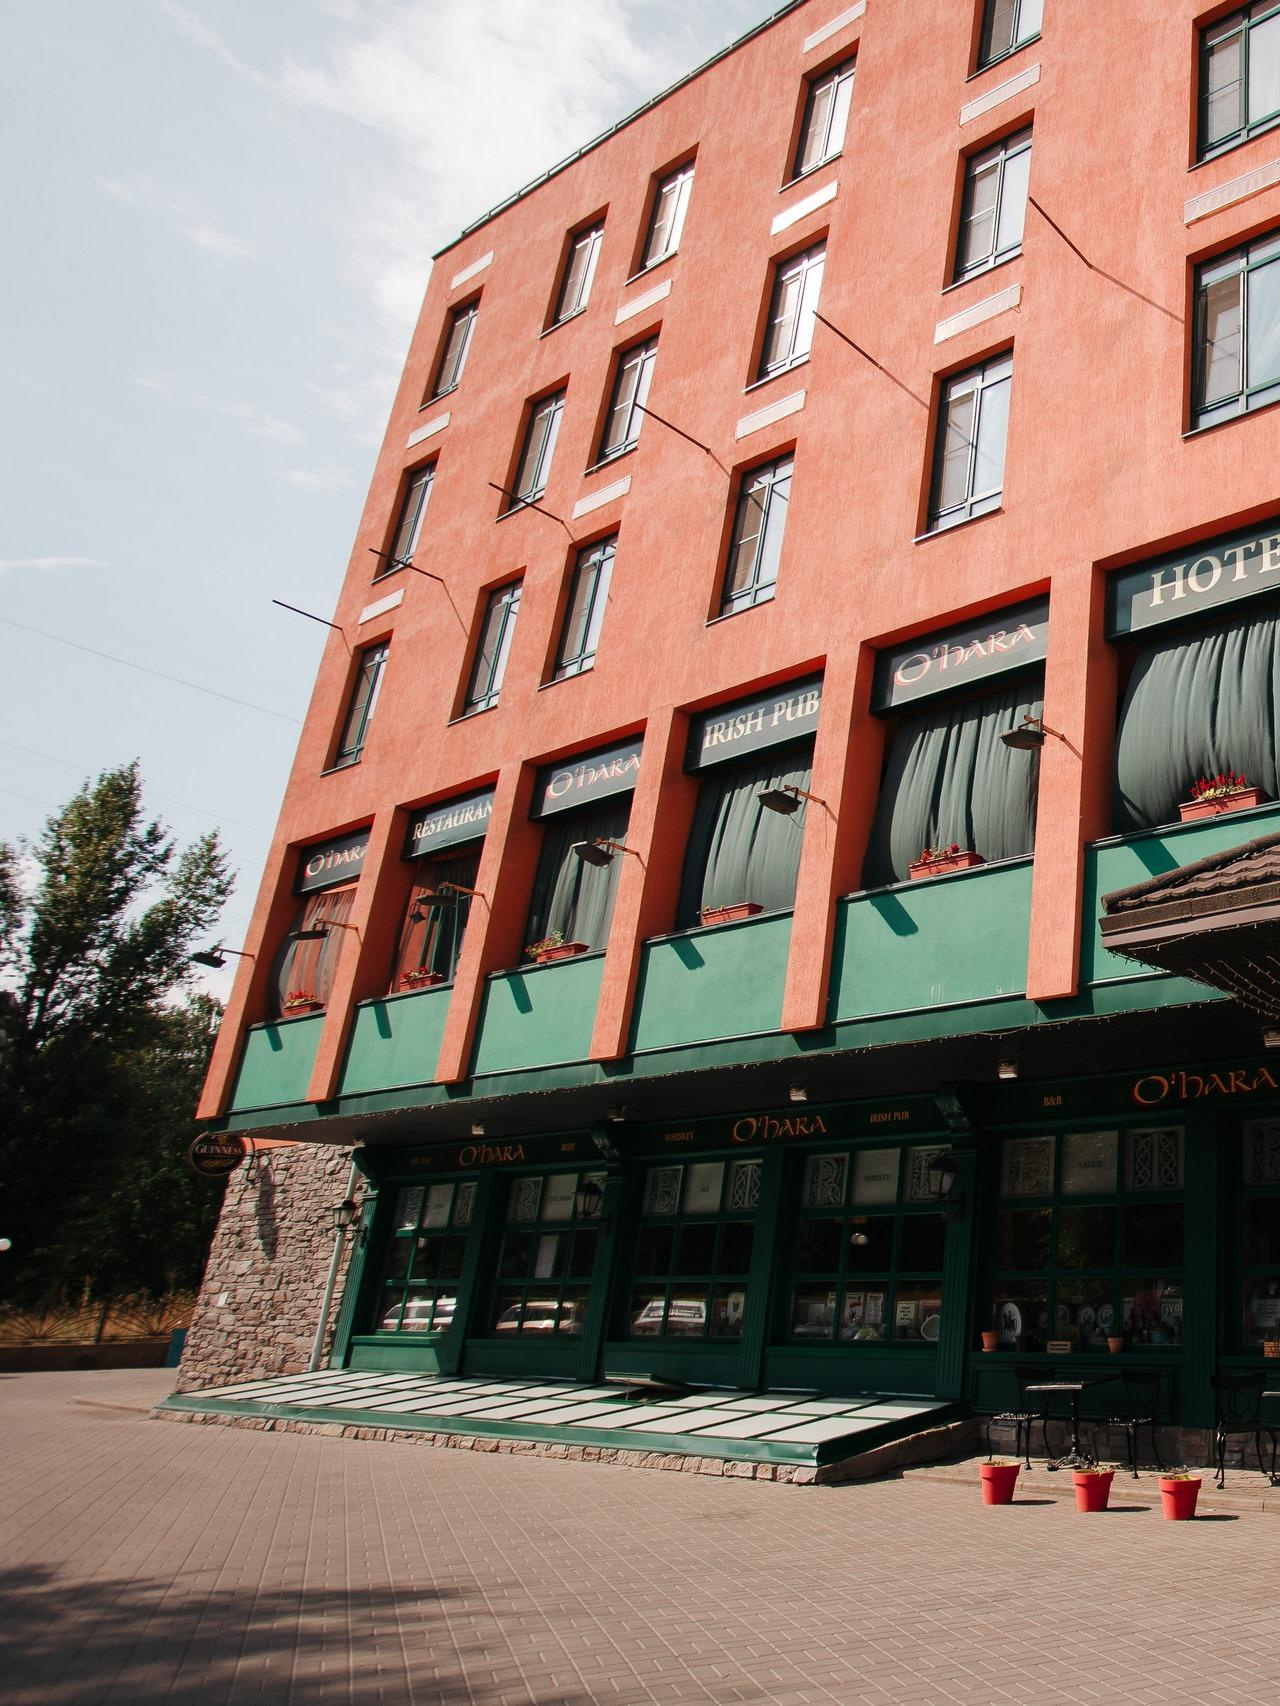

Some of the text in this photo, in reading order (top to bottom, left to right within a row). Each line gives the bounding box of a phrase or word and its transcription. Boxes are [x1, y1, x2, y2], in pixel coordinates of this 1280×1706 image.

[703, 690, 820, 749] IRISH PUB
[412, 799, 493, 841] RESTAURAN
[1042, 1095, 1062, 1106] B&B
[869, 1110, 912, 1123] IRISH PUB
